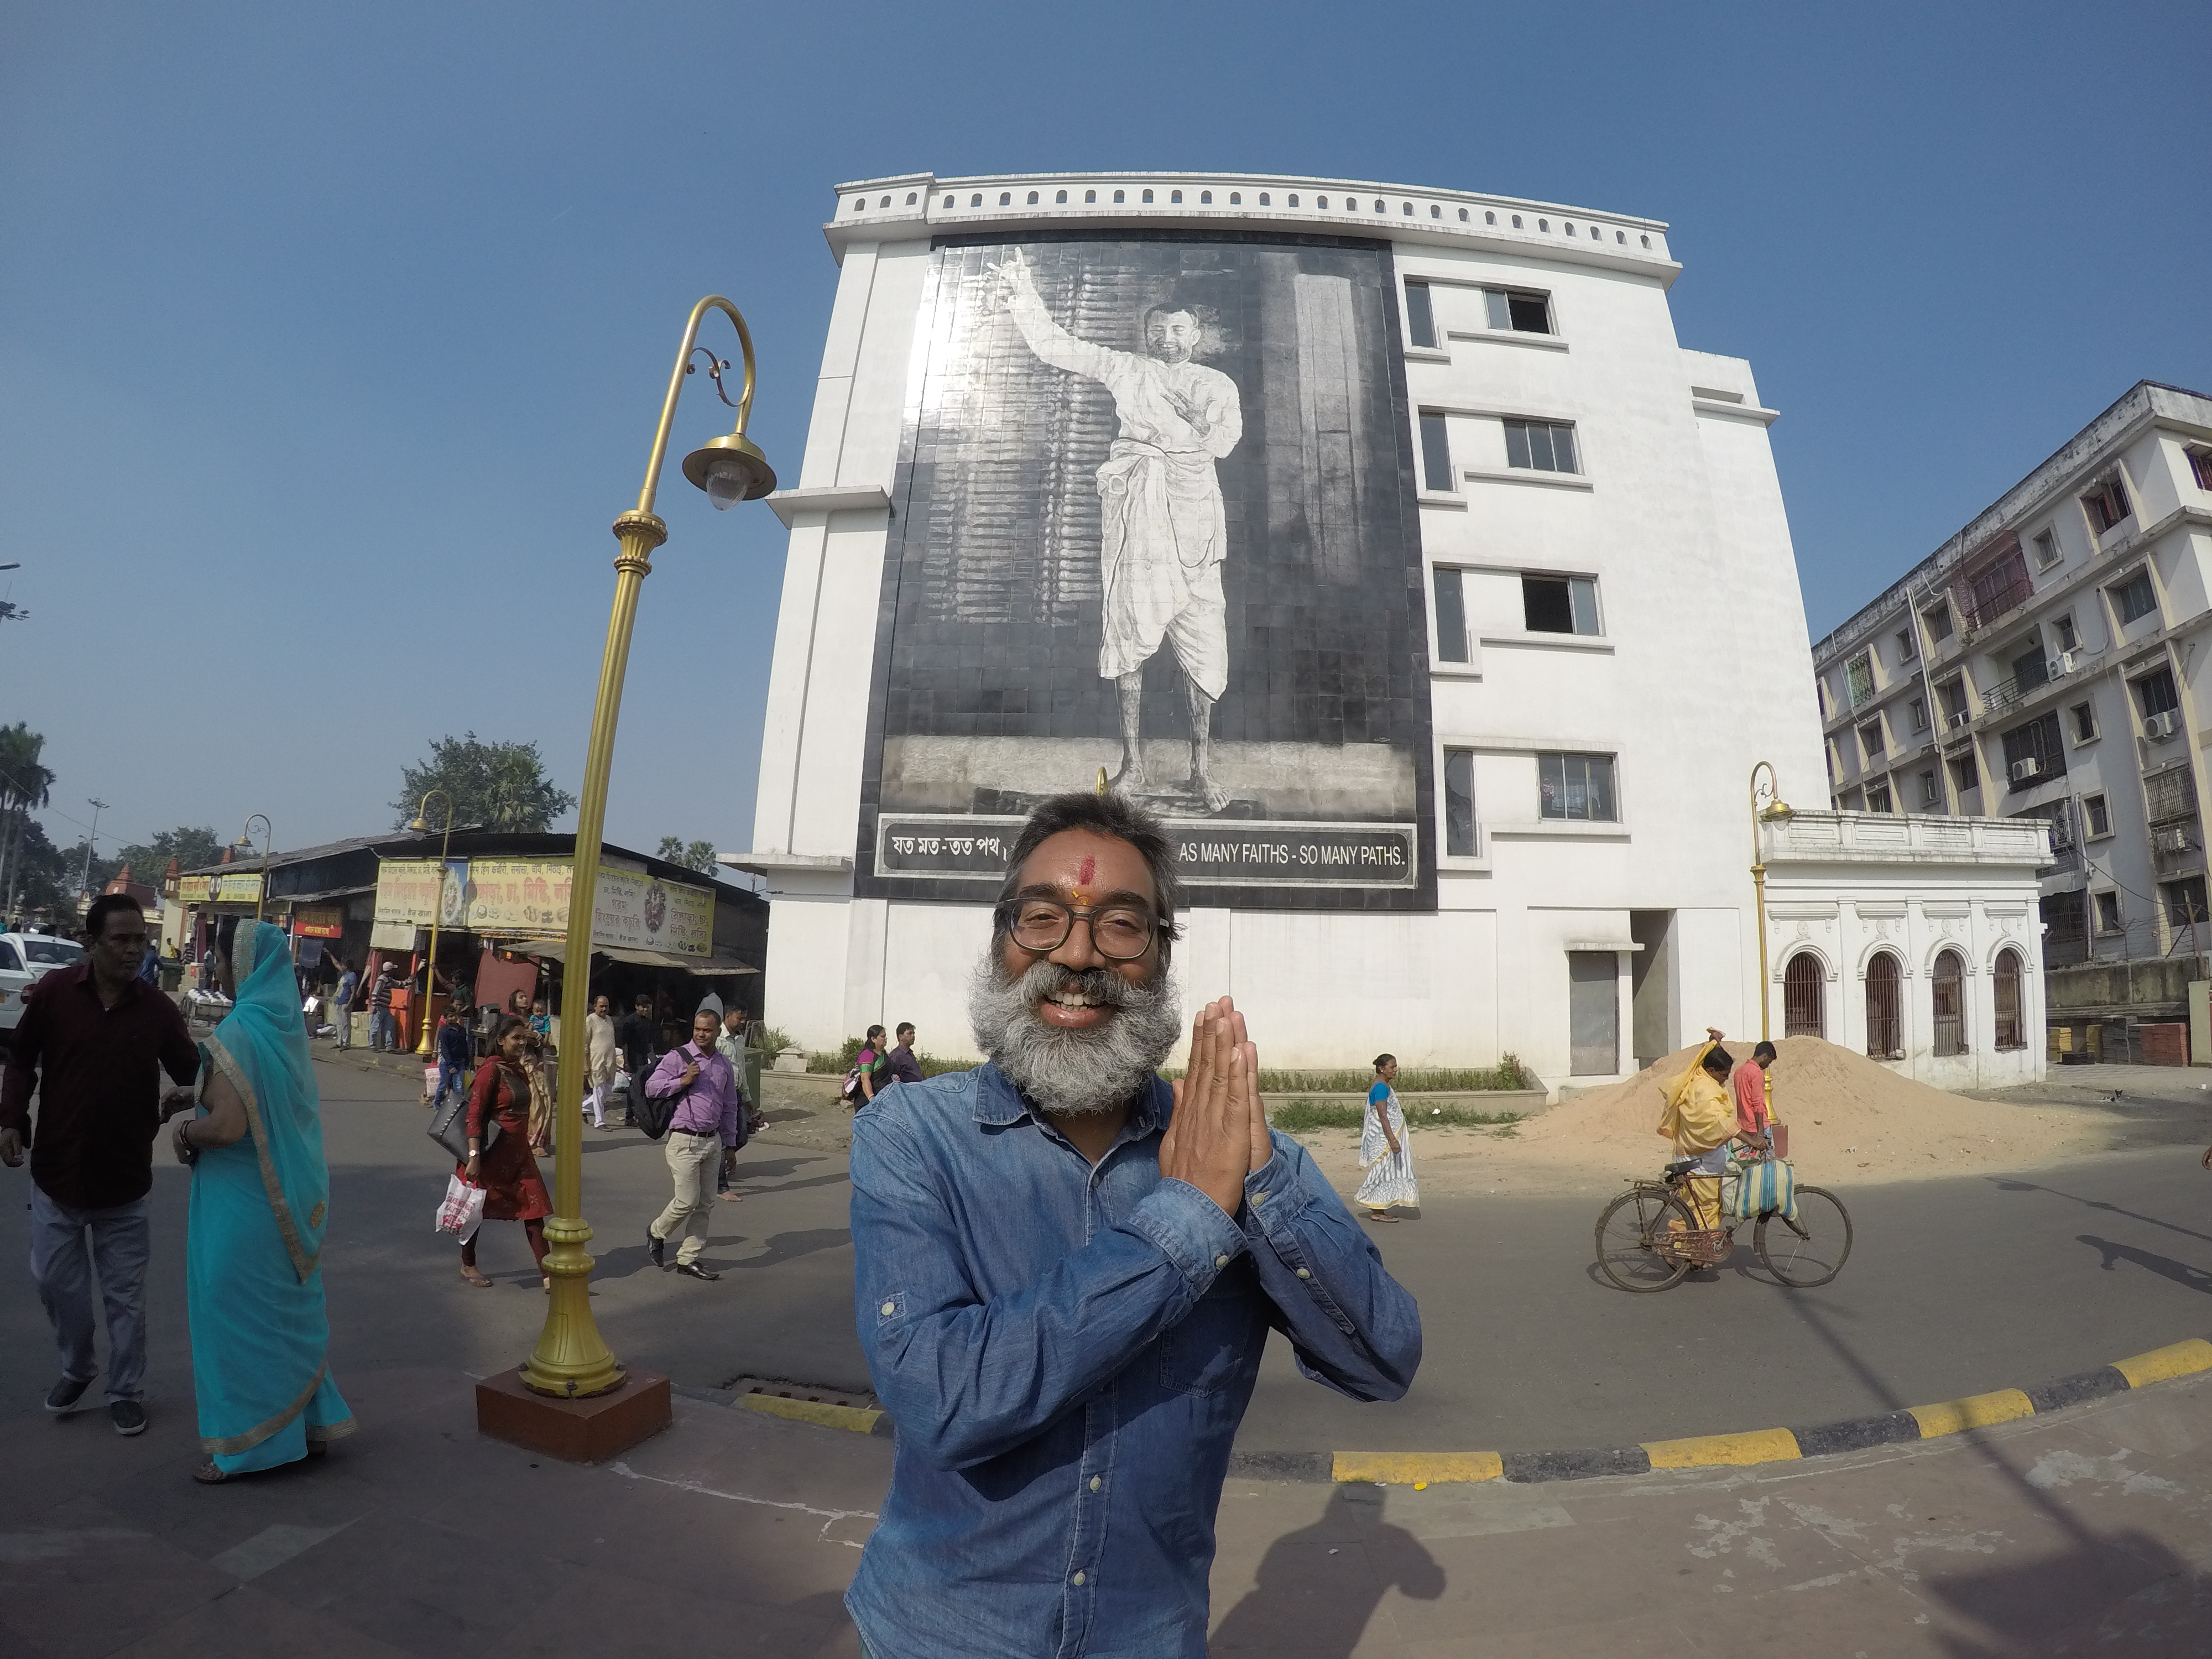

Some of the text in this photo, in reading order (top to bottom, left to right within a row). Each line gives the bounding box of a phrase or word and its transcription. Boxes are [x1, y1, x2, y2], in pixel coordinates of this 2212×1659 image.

[891, 837, 915, 855] যত
[1179, 842, 1197, 862] AS
[1201, 842, 1239, 863] MANY
[1242, 843, 1288, 864] FAITHS
[1300, 844, 1318, 864] SO
[1321, 845, 1358, 865] MANY
[1361, 846, 1405, 865] PATHS.
